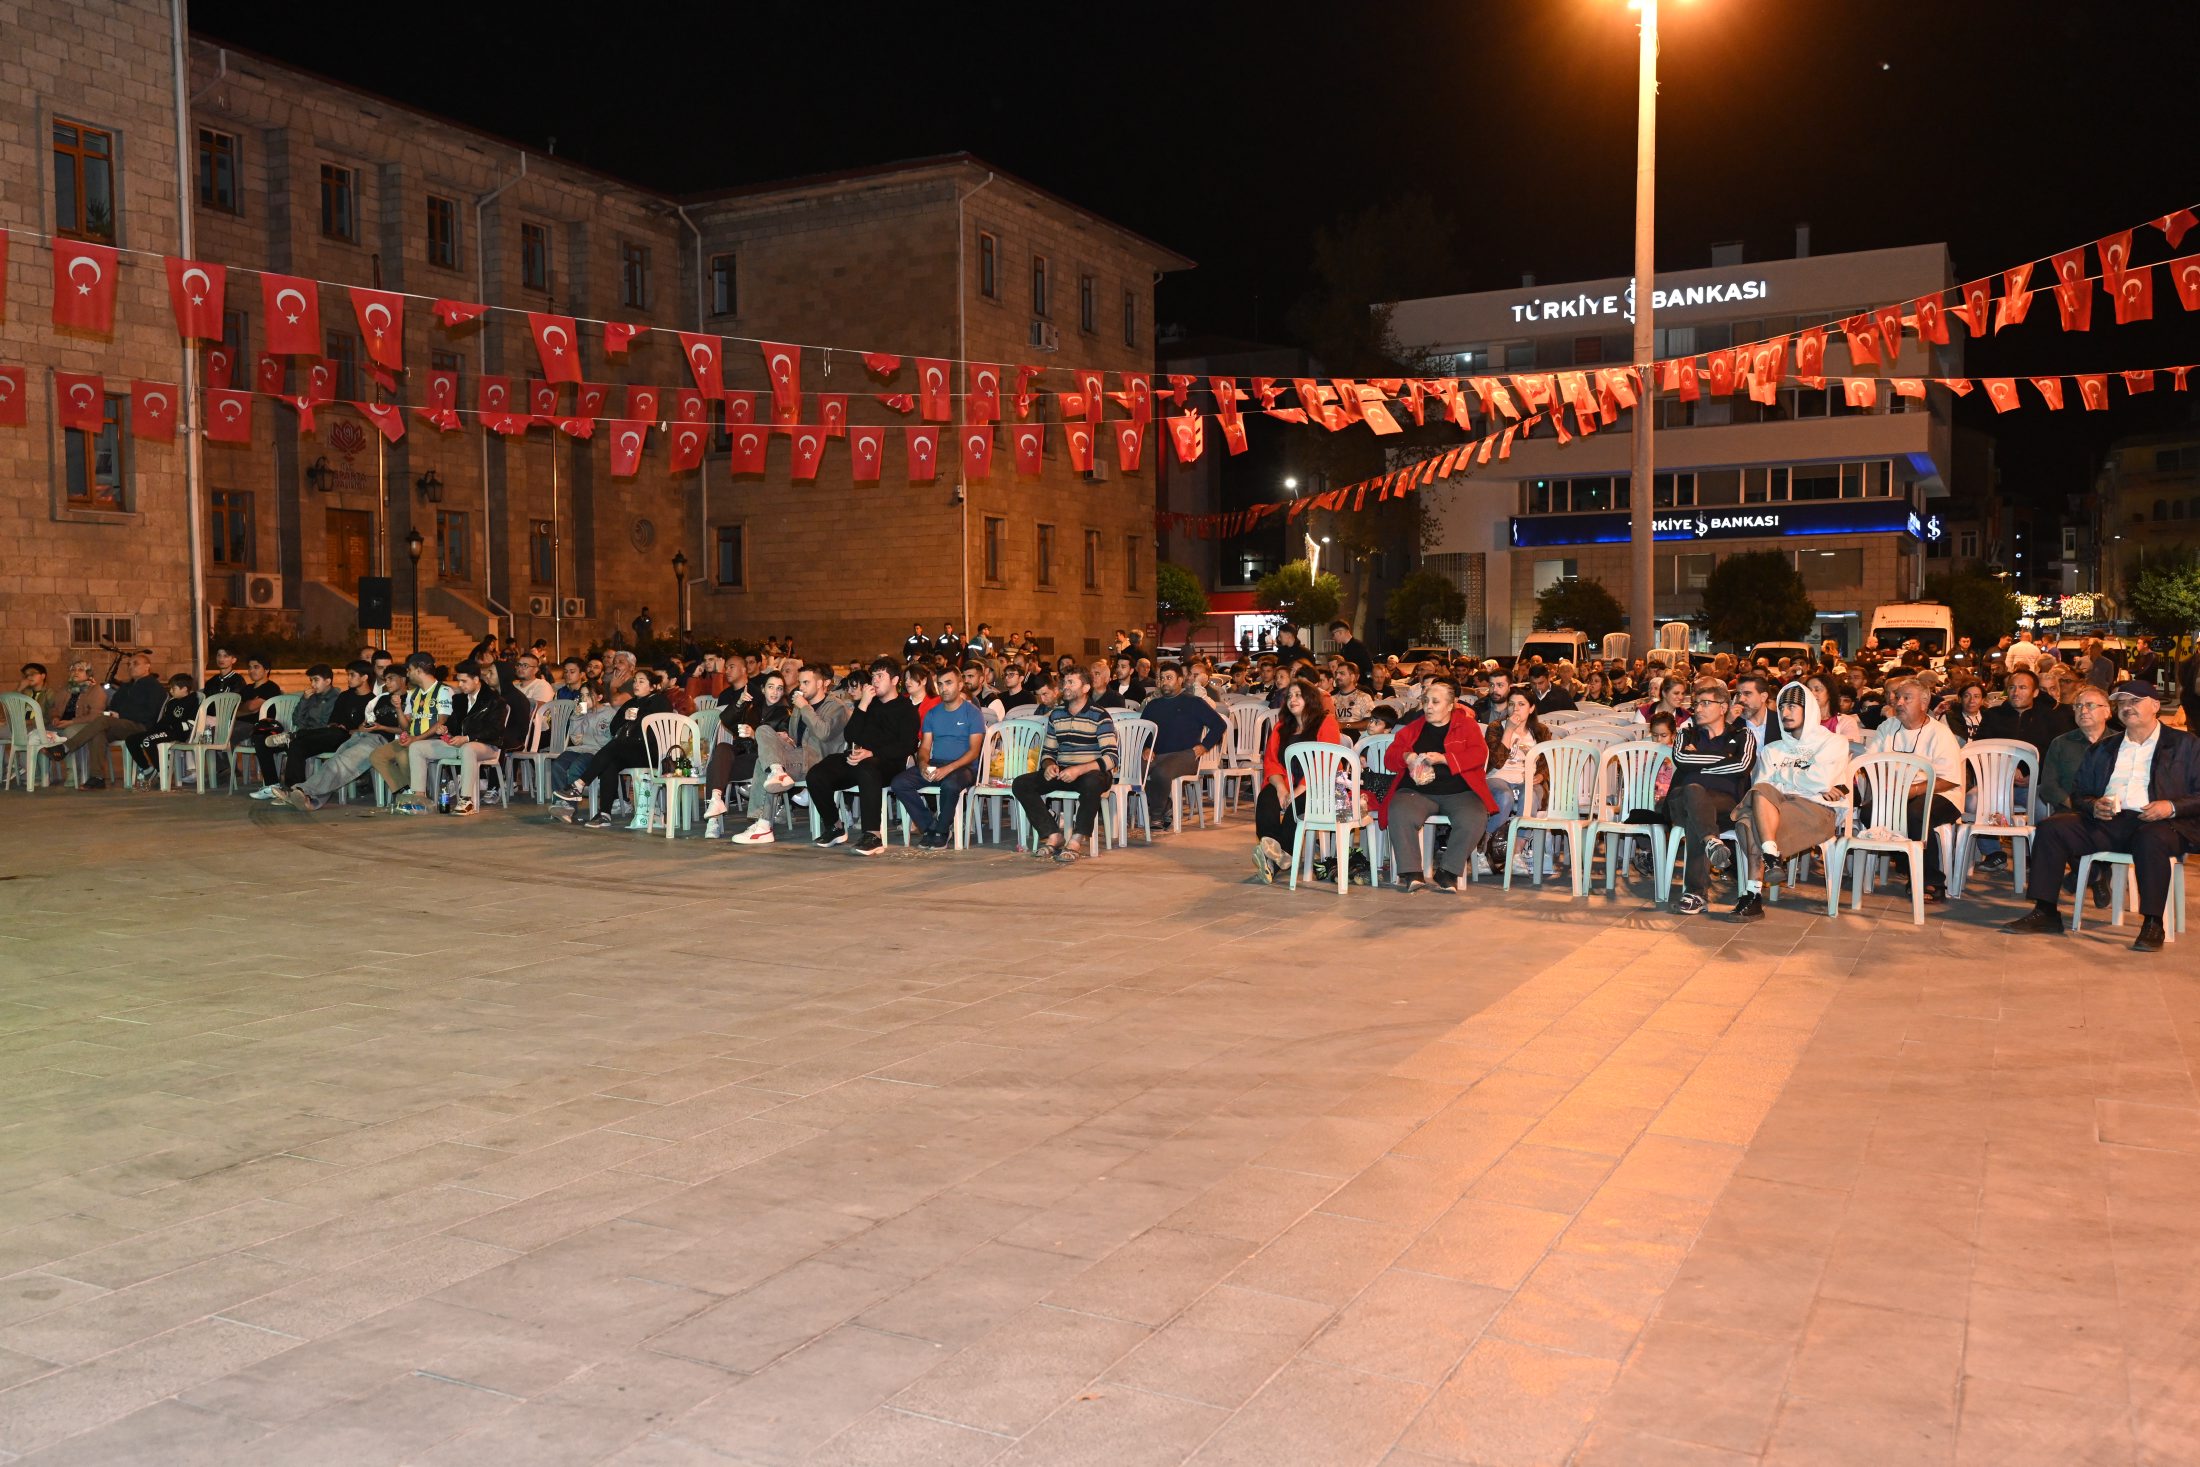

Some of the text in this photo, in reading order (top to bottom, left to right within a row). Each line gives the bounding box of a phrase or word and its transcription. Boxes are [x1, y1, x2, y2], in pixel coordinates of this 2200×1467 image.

[1511, 294, 1618, 322] TÜRKİYE
[1652, 281, 1766, 309] BANKASI
[1628, 518, 1692, 531] RKİYE
[1711, 515, 1779, 529] BANKASI
[1335, 708, 1352, 717] VIS
